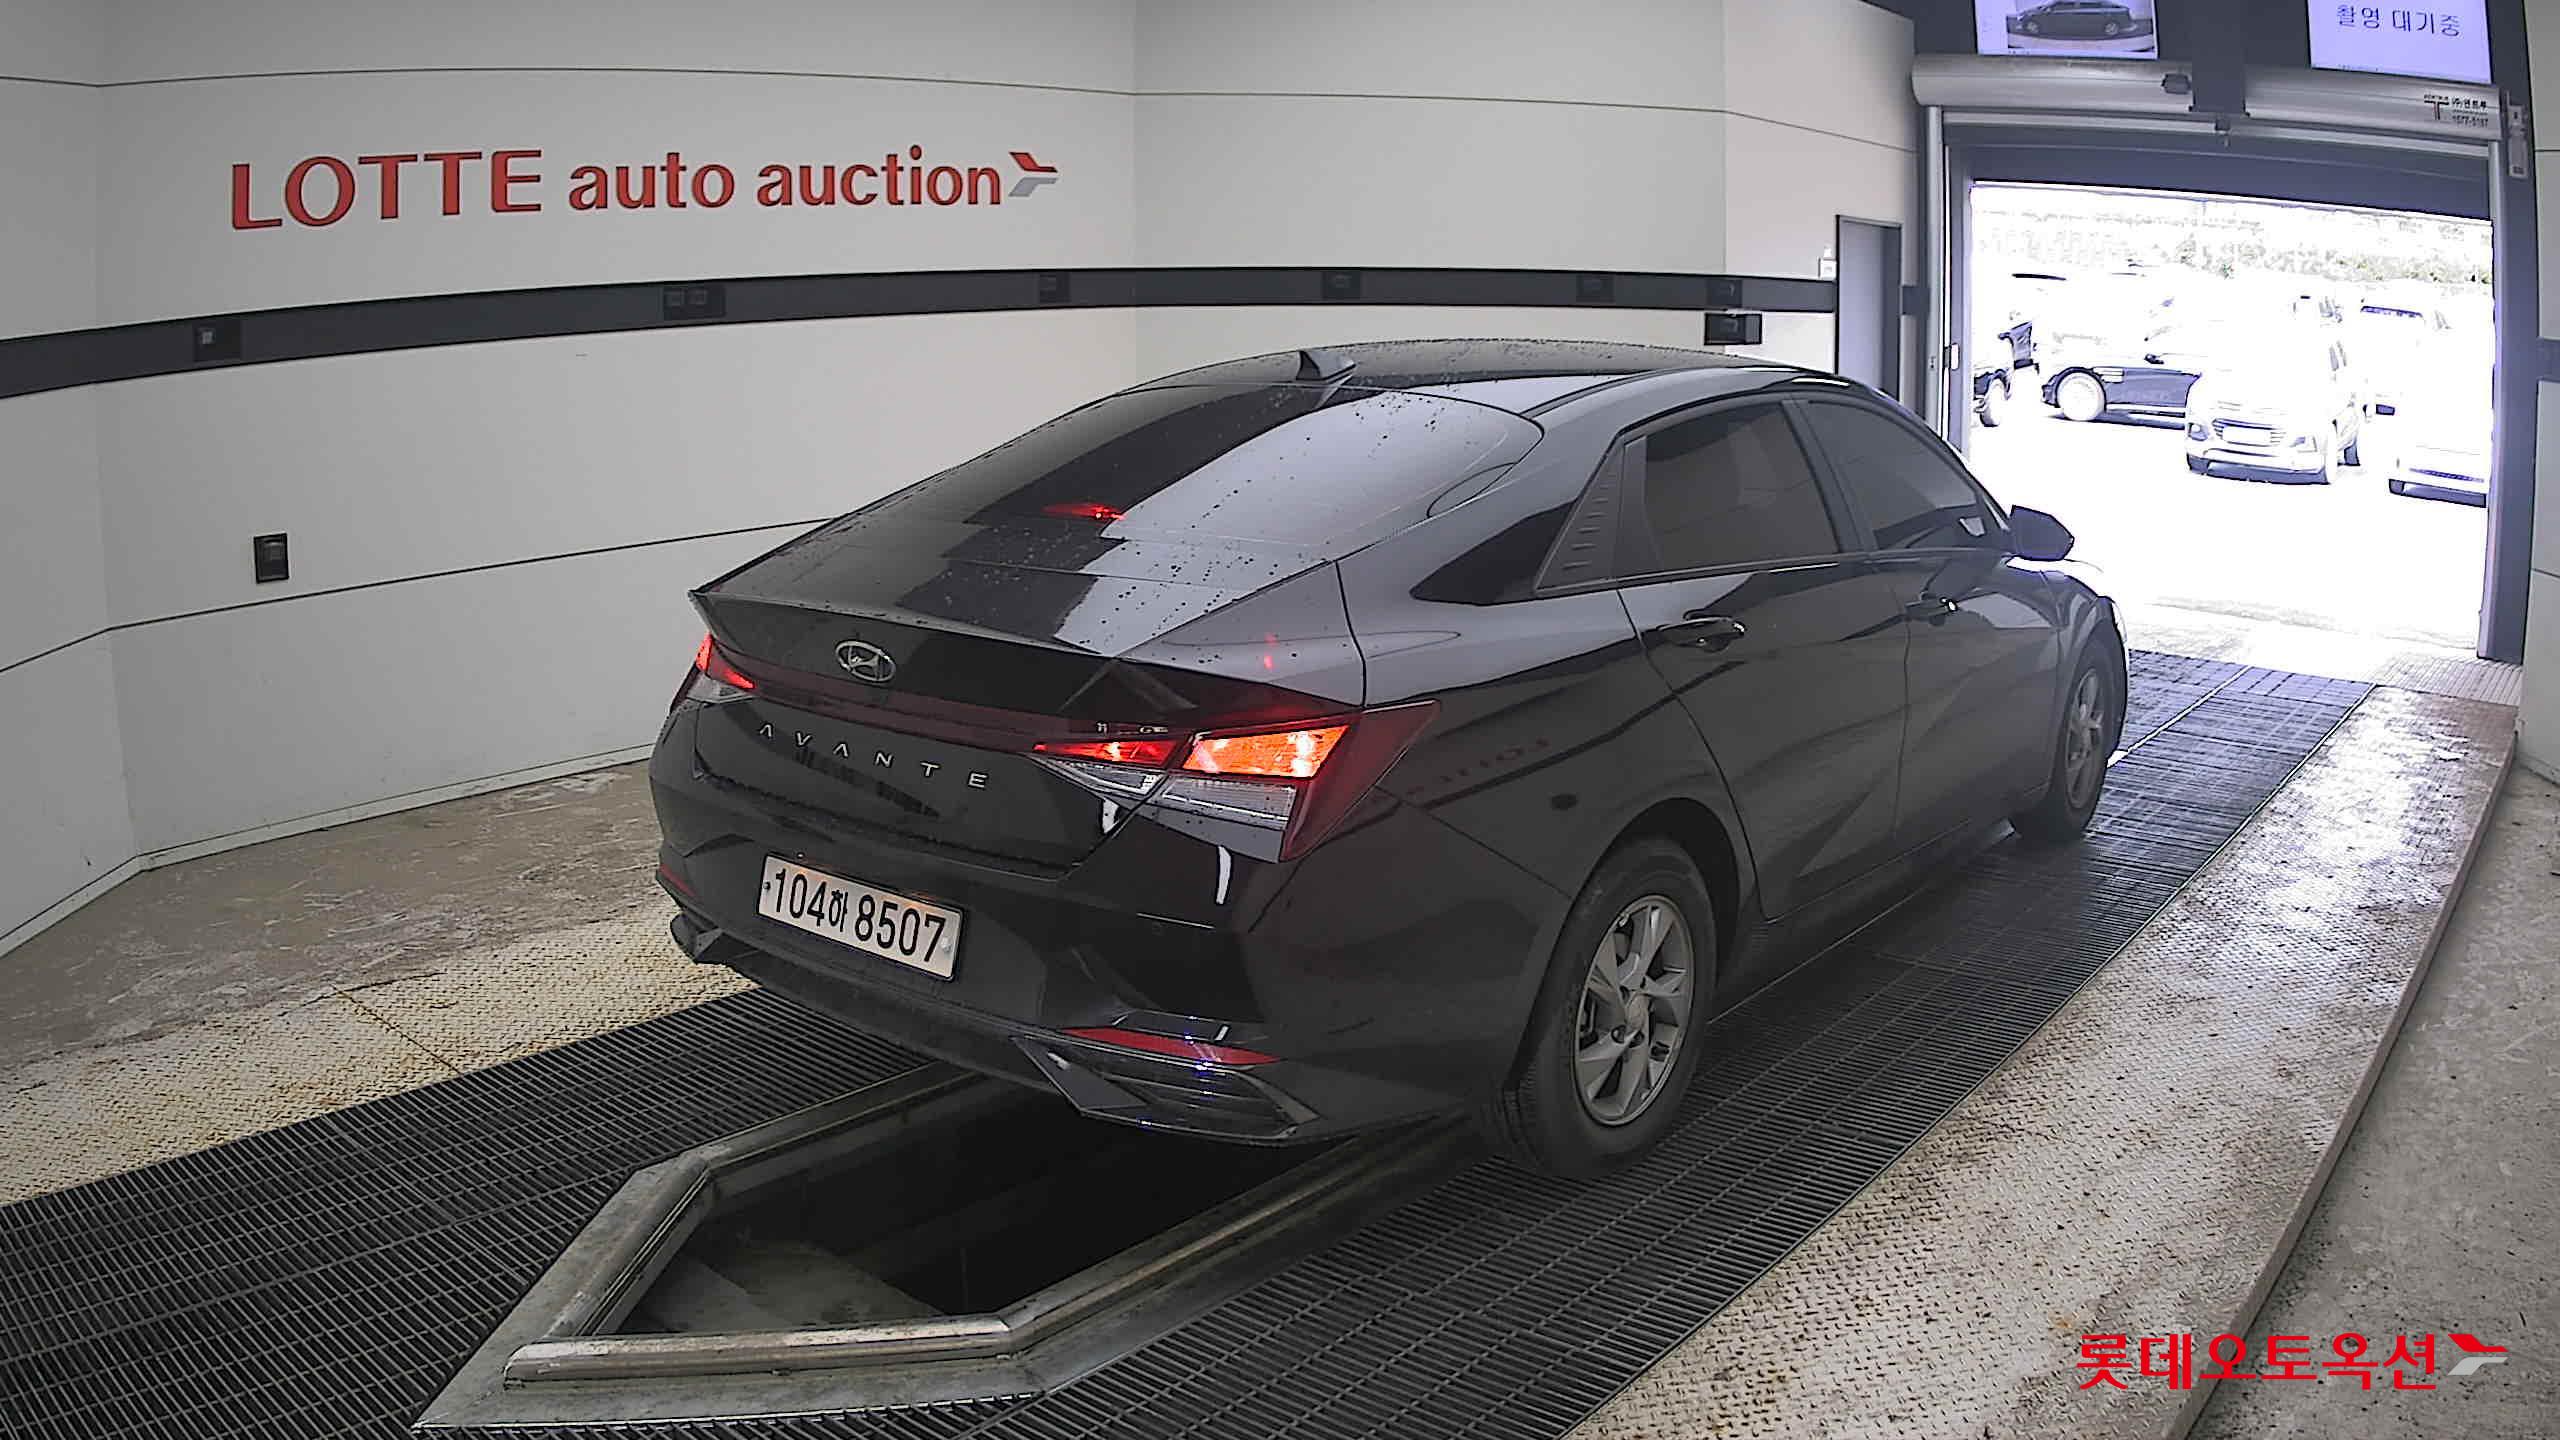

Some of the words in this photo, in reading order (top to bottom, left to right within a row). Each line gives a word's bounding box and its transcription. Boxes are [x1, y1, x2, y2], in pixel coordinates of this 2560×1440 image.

[2338, 4, 2381, 30] 촬영
[2392, 10, 2460, 37] 대기중
[231, 150, 543, 230] LOTTE
[568, 152, 736, 209] auto
[756, 145, 1003, 208] auction
[759, 724, 988, 788] AVANTE
[776, 868, 849, 932] 104하
[855, 894, 946, 962] 8507
